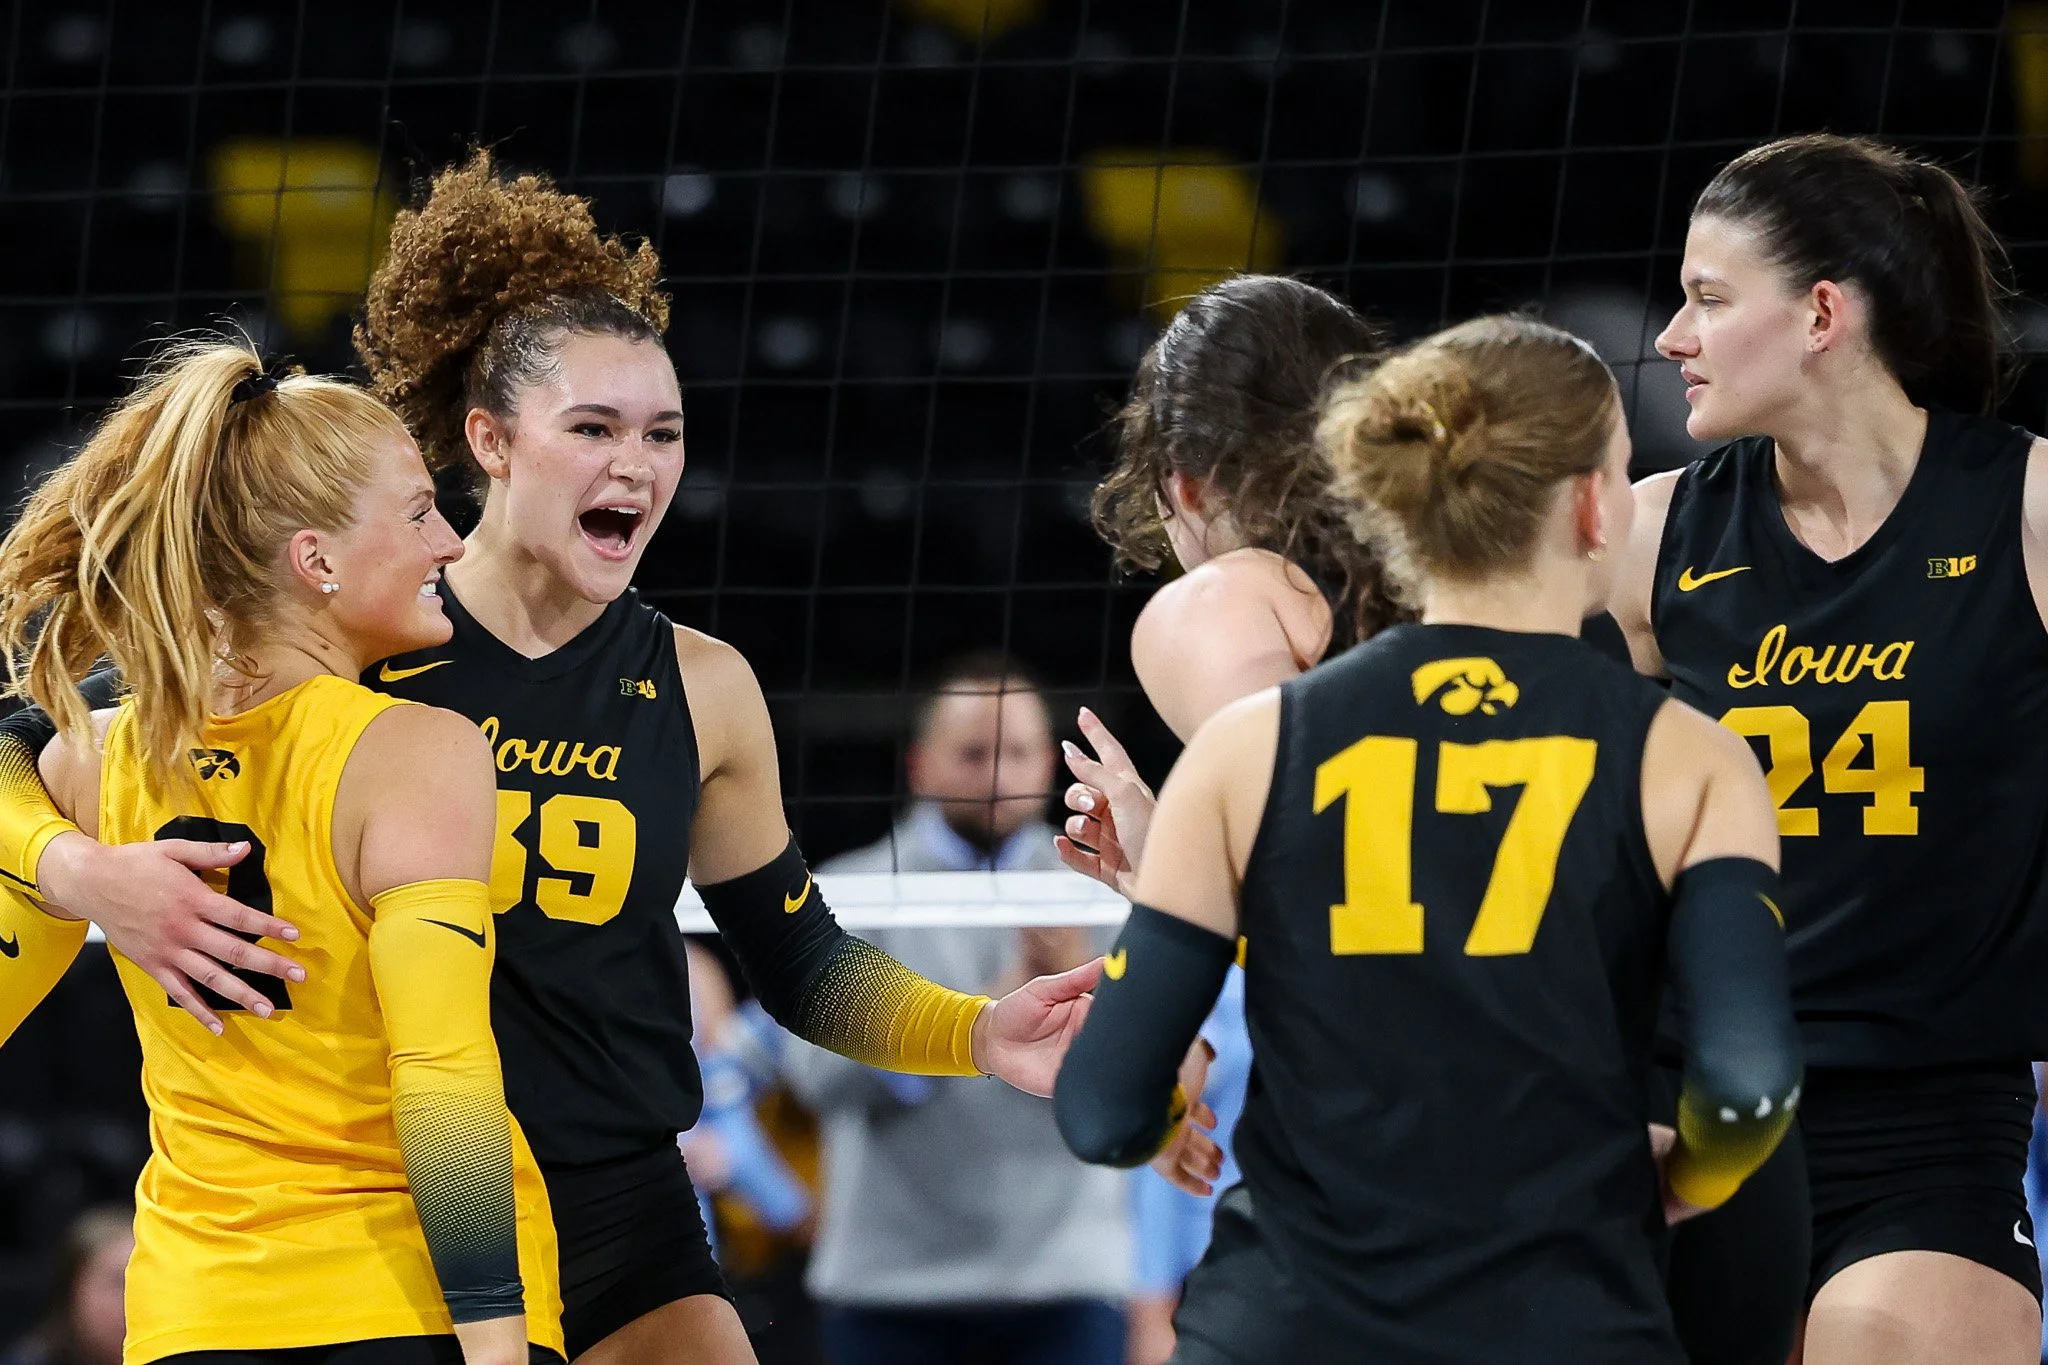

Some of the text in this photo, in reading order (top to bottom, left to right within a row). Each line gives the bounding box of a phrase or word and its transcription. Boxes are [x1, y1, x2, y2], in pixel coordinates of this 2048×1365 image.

[1727, 624, 1915, 689] Iowa
[1718, 700, 1924, 837] 24
[1313, 735, 1598, 956] 17
